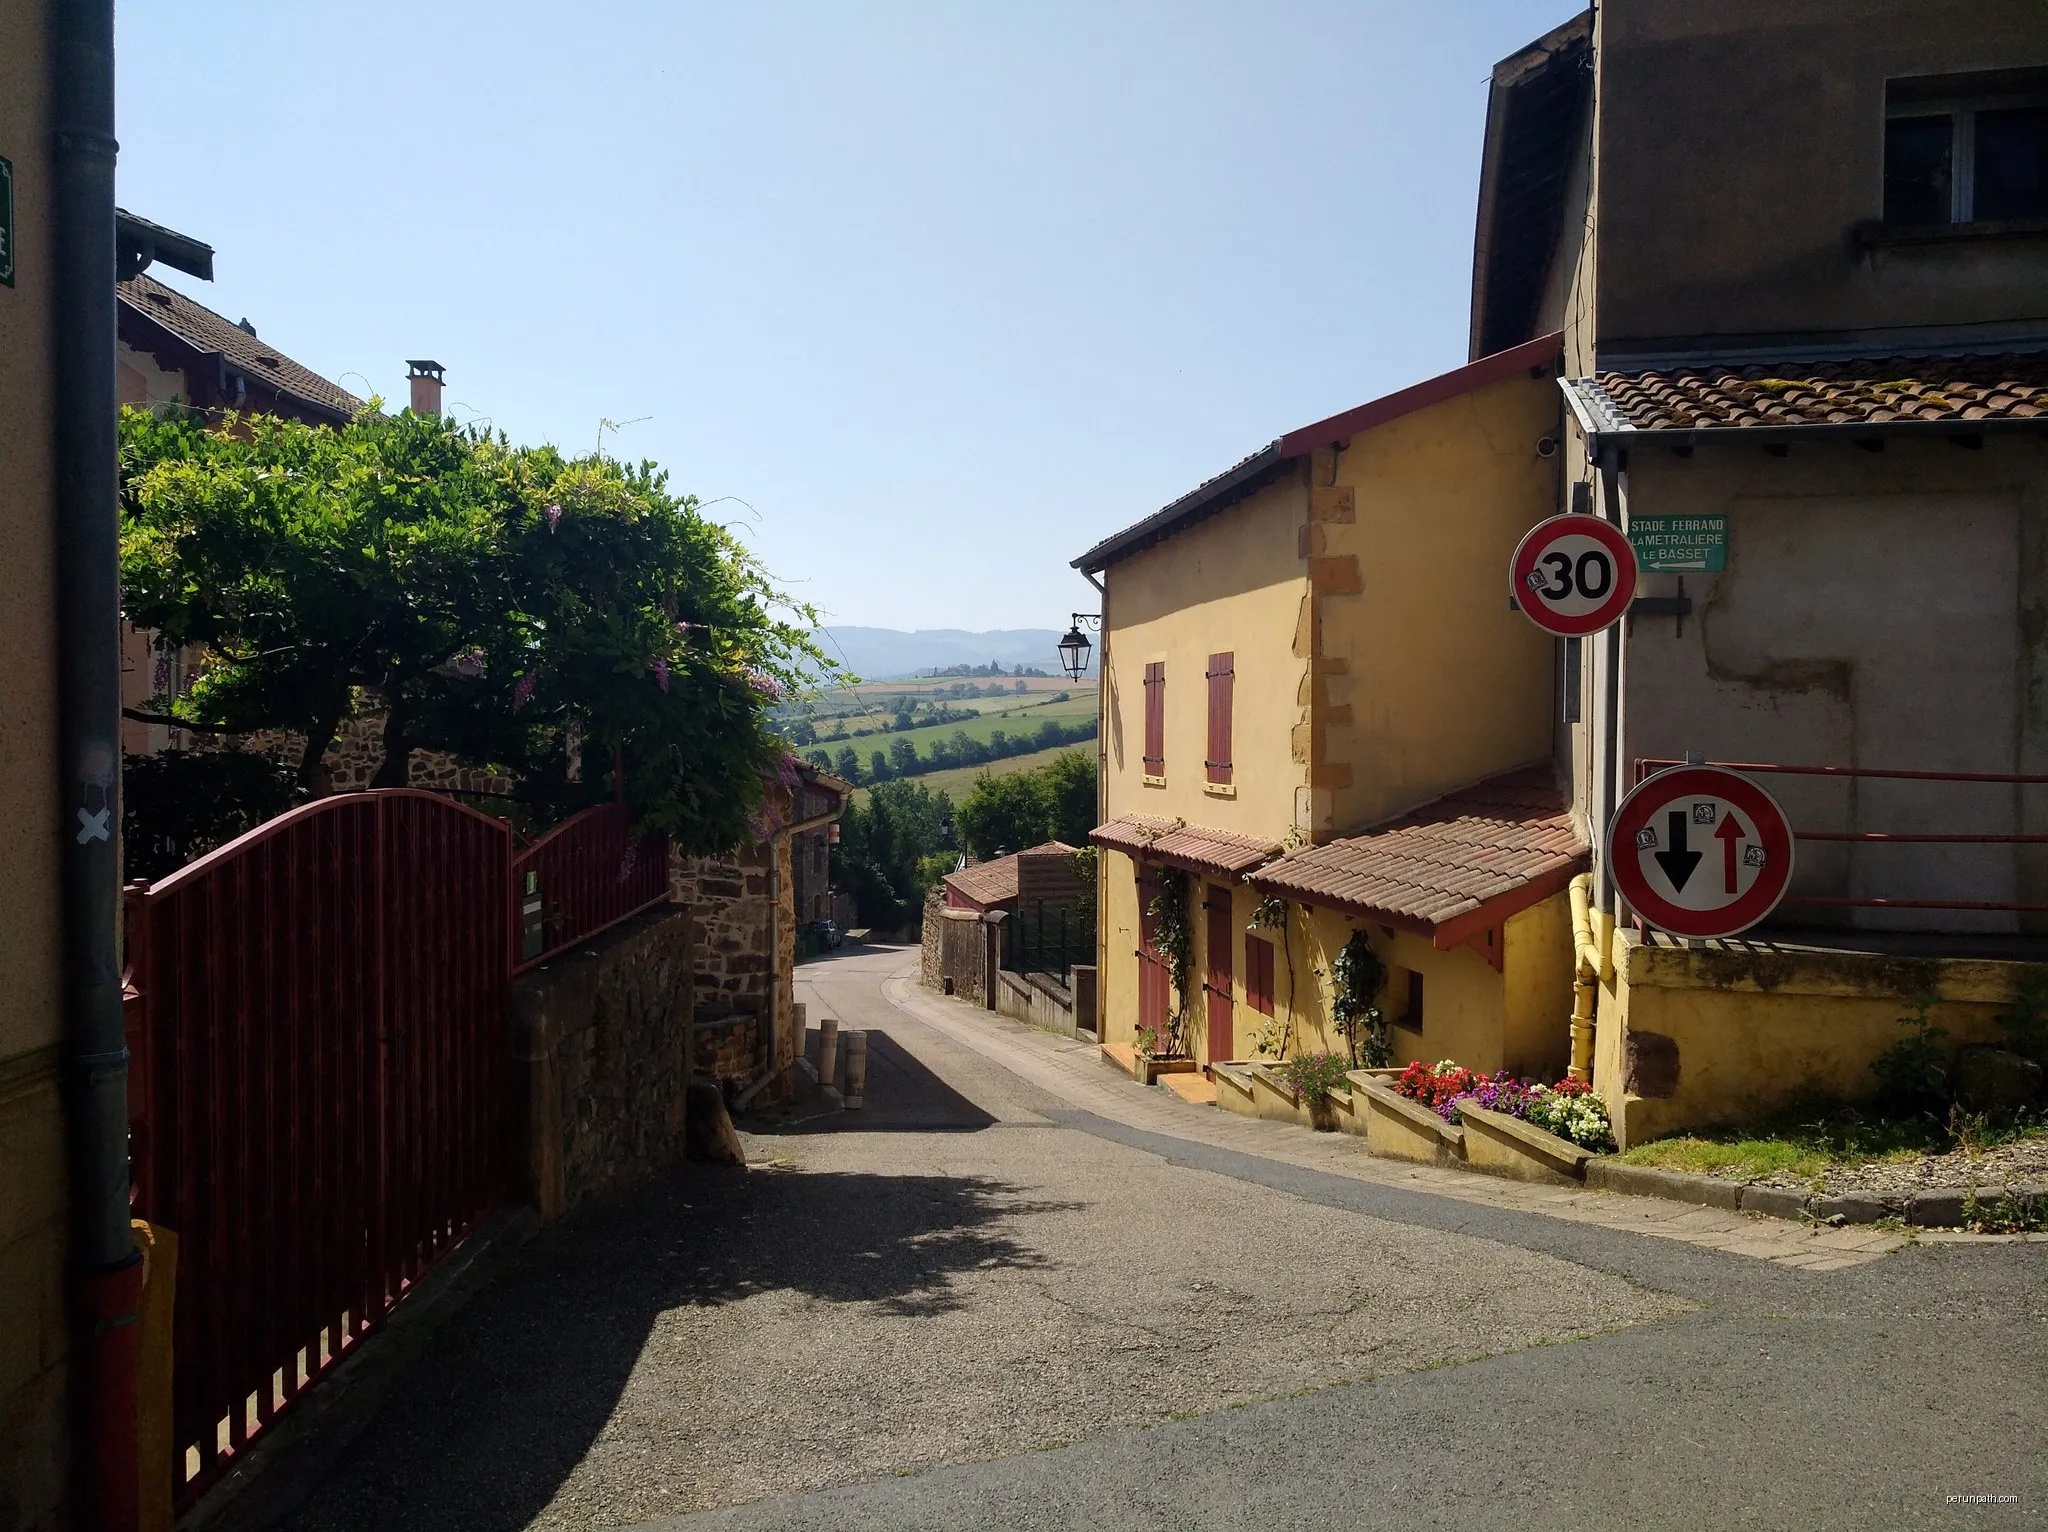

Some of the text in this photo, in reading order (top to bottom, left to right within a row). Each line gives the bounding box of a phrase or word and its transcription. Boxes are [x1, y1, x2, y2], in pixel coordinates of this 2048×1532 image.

[1631, 519, 1724, 532] STADE FERRAND
[1643, 548, 1710, 560] LE BASSET
[1541, 550, 1612, 600] 30
